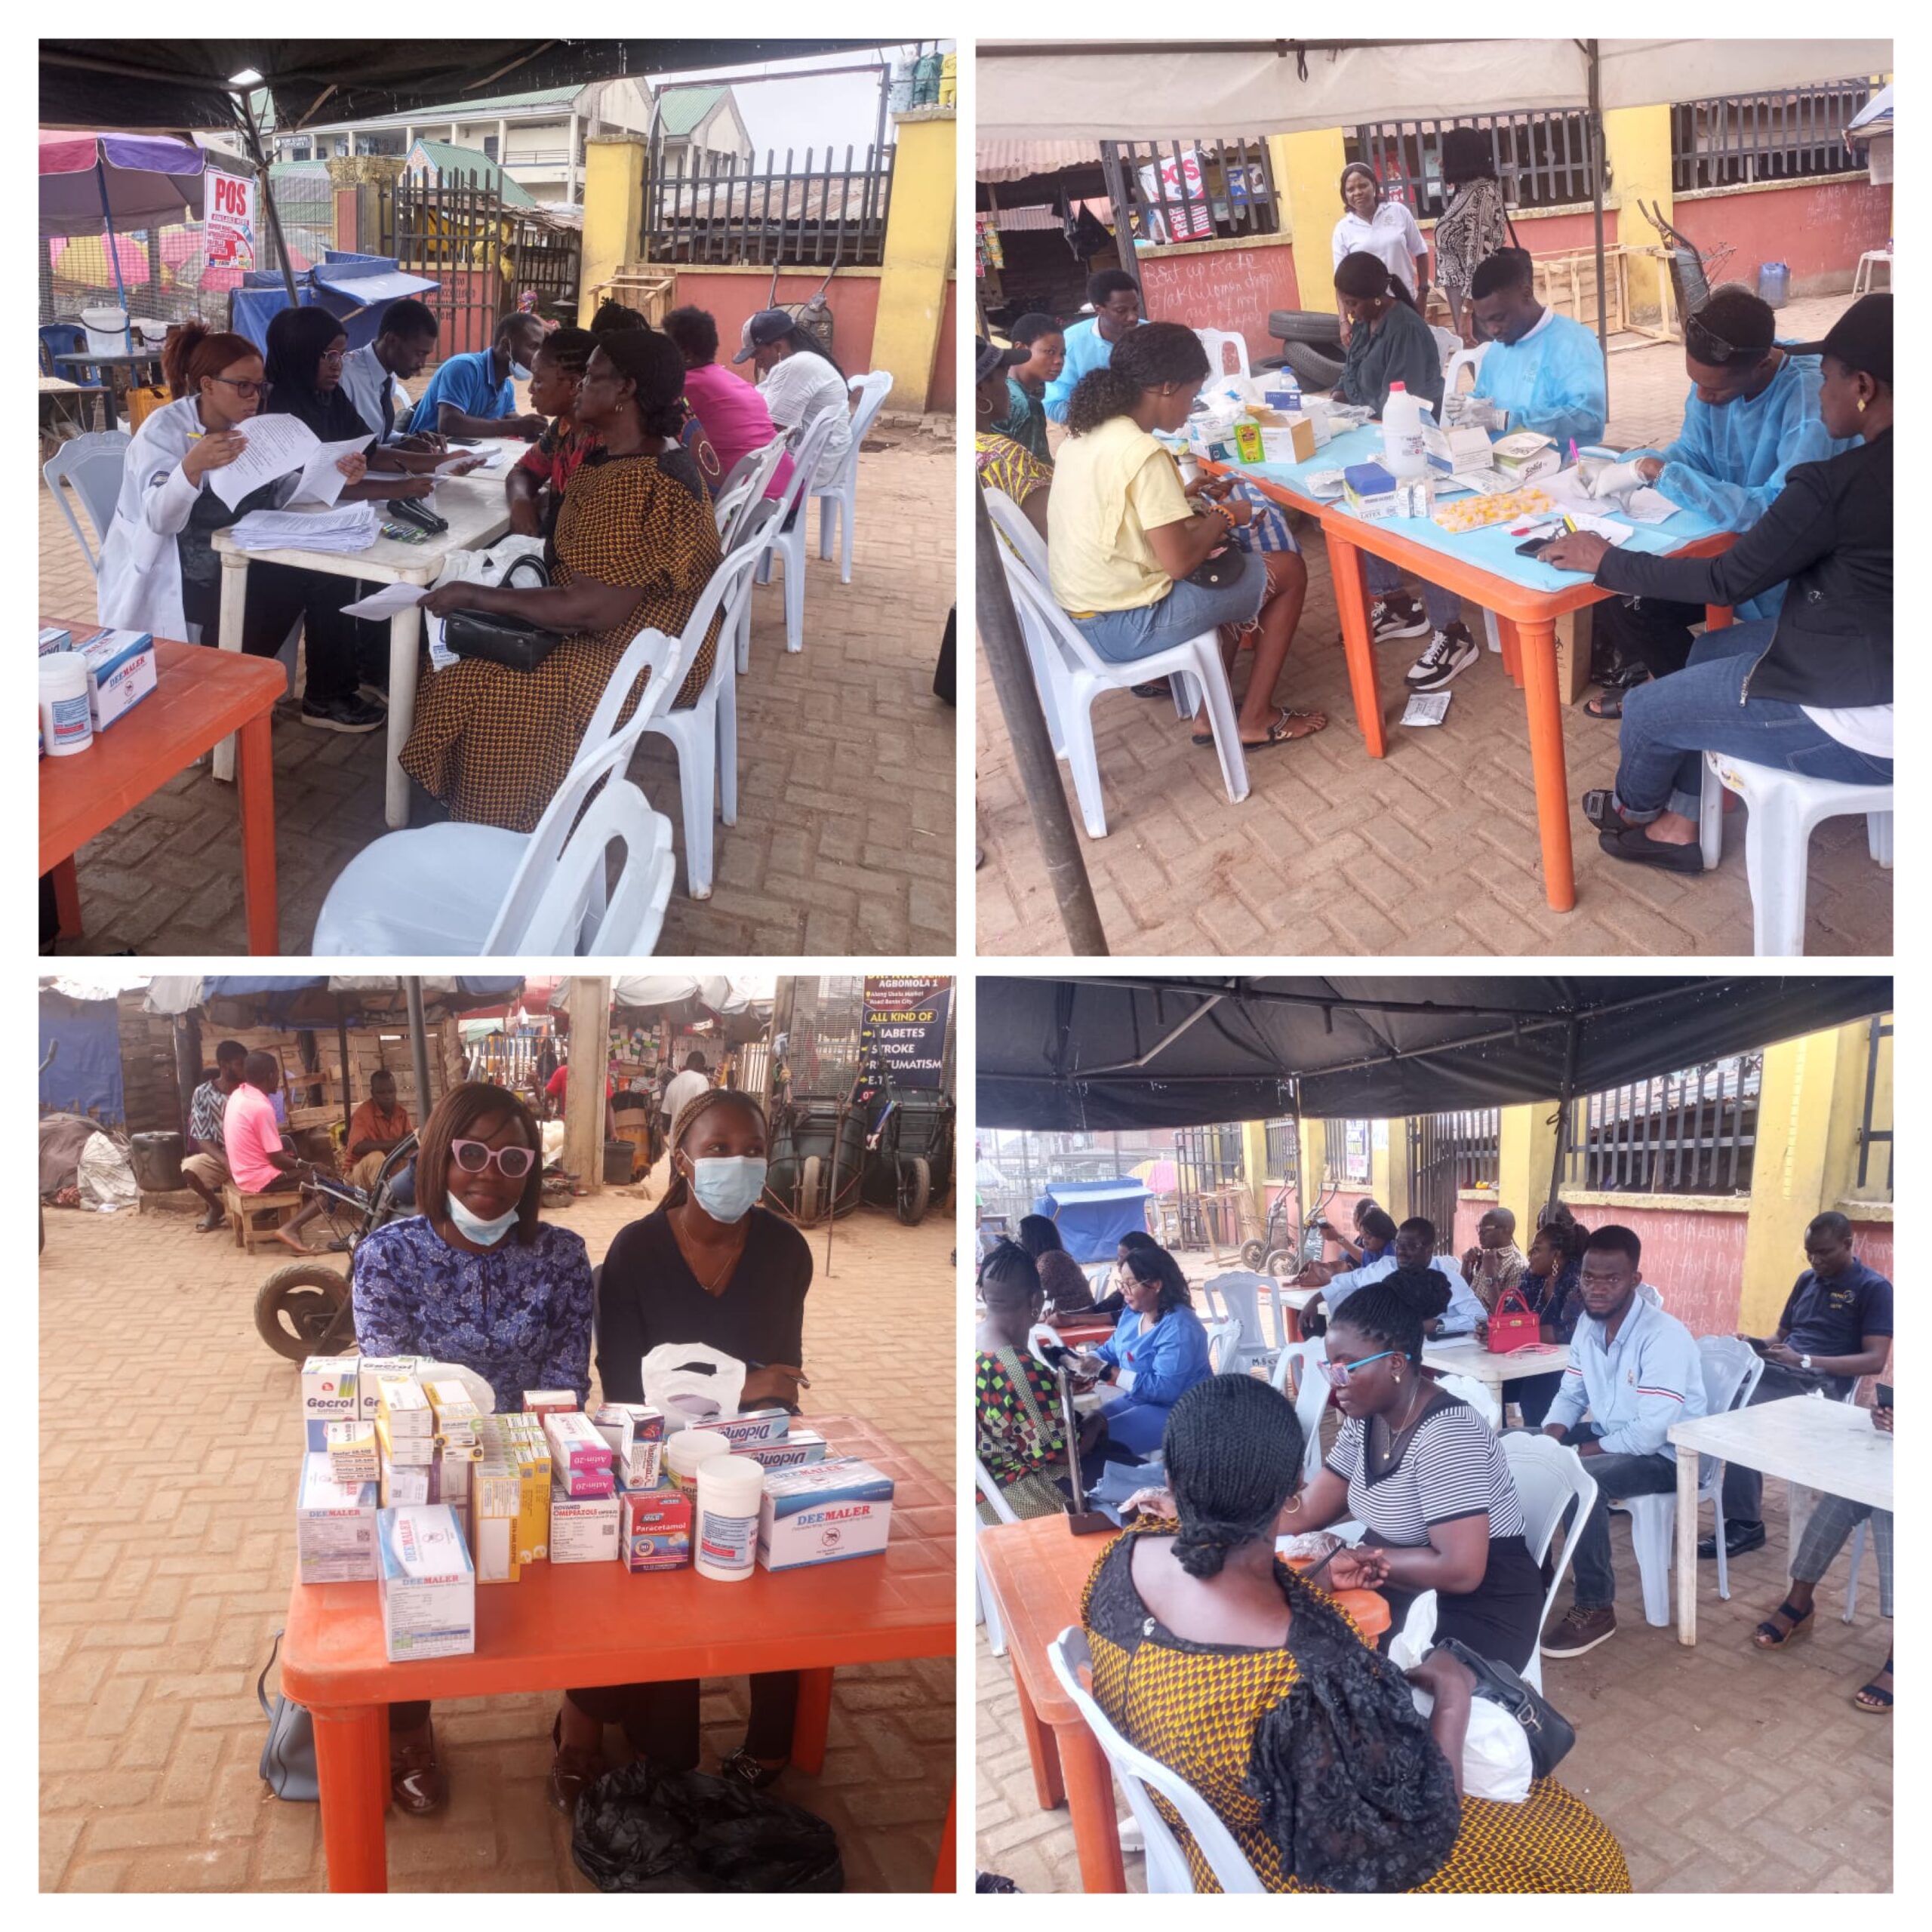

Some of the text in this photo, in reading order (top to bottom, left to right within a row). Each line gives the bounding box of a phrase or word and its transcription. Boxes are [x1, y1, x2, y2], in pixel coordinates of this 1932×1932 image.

[215, 177, 246, 217] POS
[109, 655, 146, 688] DEEMALER
[878, 979, 938, 988] AGBOMOLA 1
[870, 1011, 933, 1023] ALL KIND OF
[872, 1028, 925, 1038] IABETES
[871, 1044, 915, 1054] STROKE
[869, 1059, 942, 1069] RUMATISM
[306, 1397, 355, 1408] Gecrol
[773, 1463, 846, 1479] DEEMALER
[309, 1509, 361, 1518] DEEMALER
[797, 1504, 871, 1526] DEEMALER
[635, 1521, 686, 1532] Paracetamol
[398, 1519, 417, 1562] DEEMALER
[402, 1574, 460, 1586] DEEMALER
